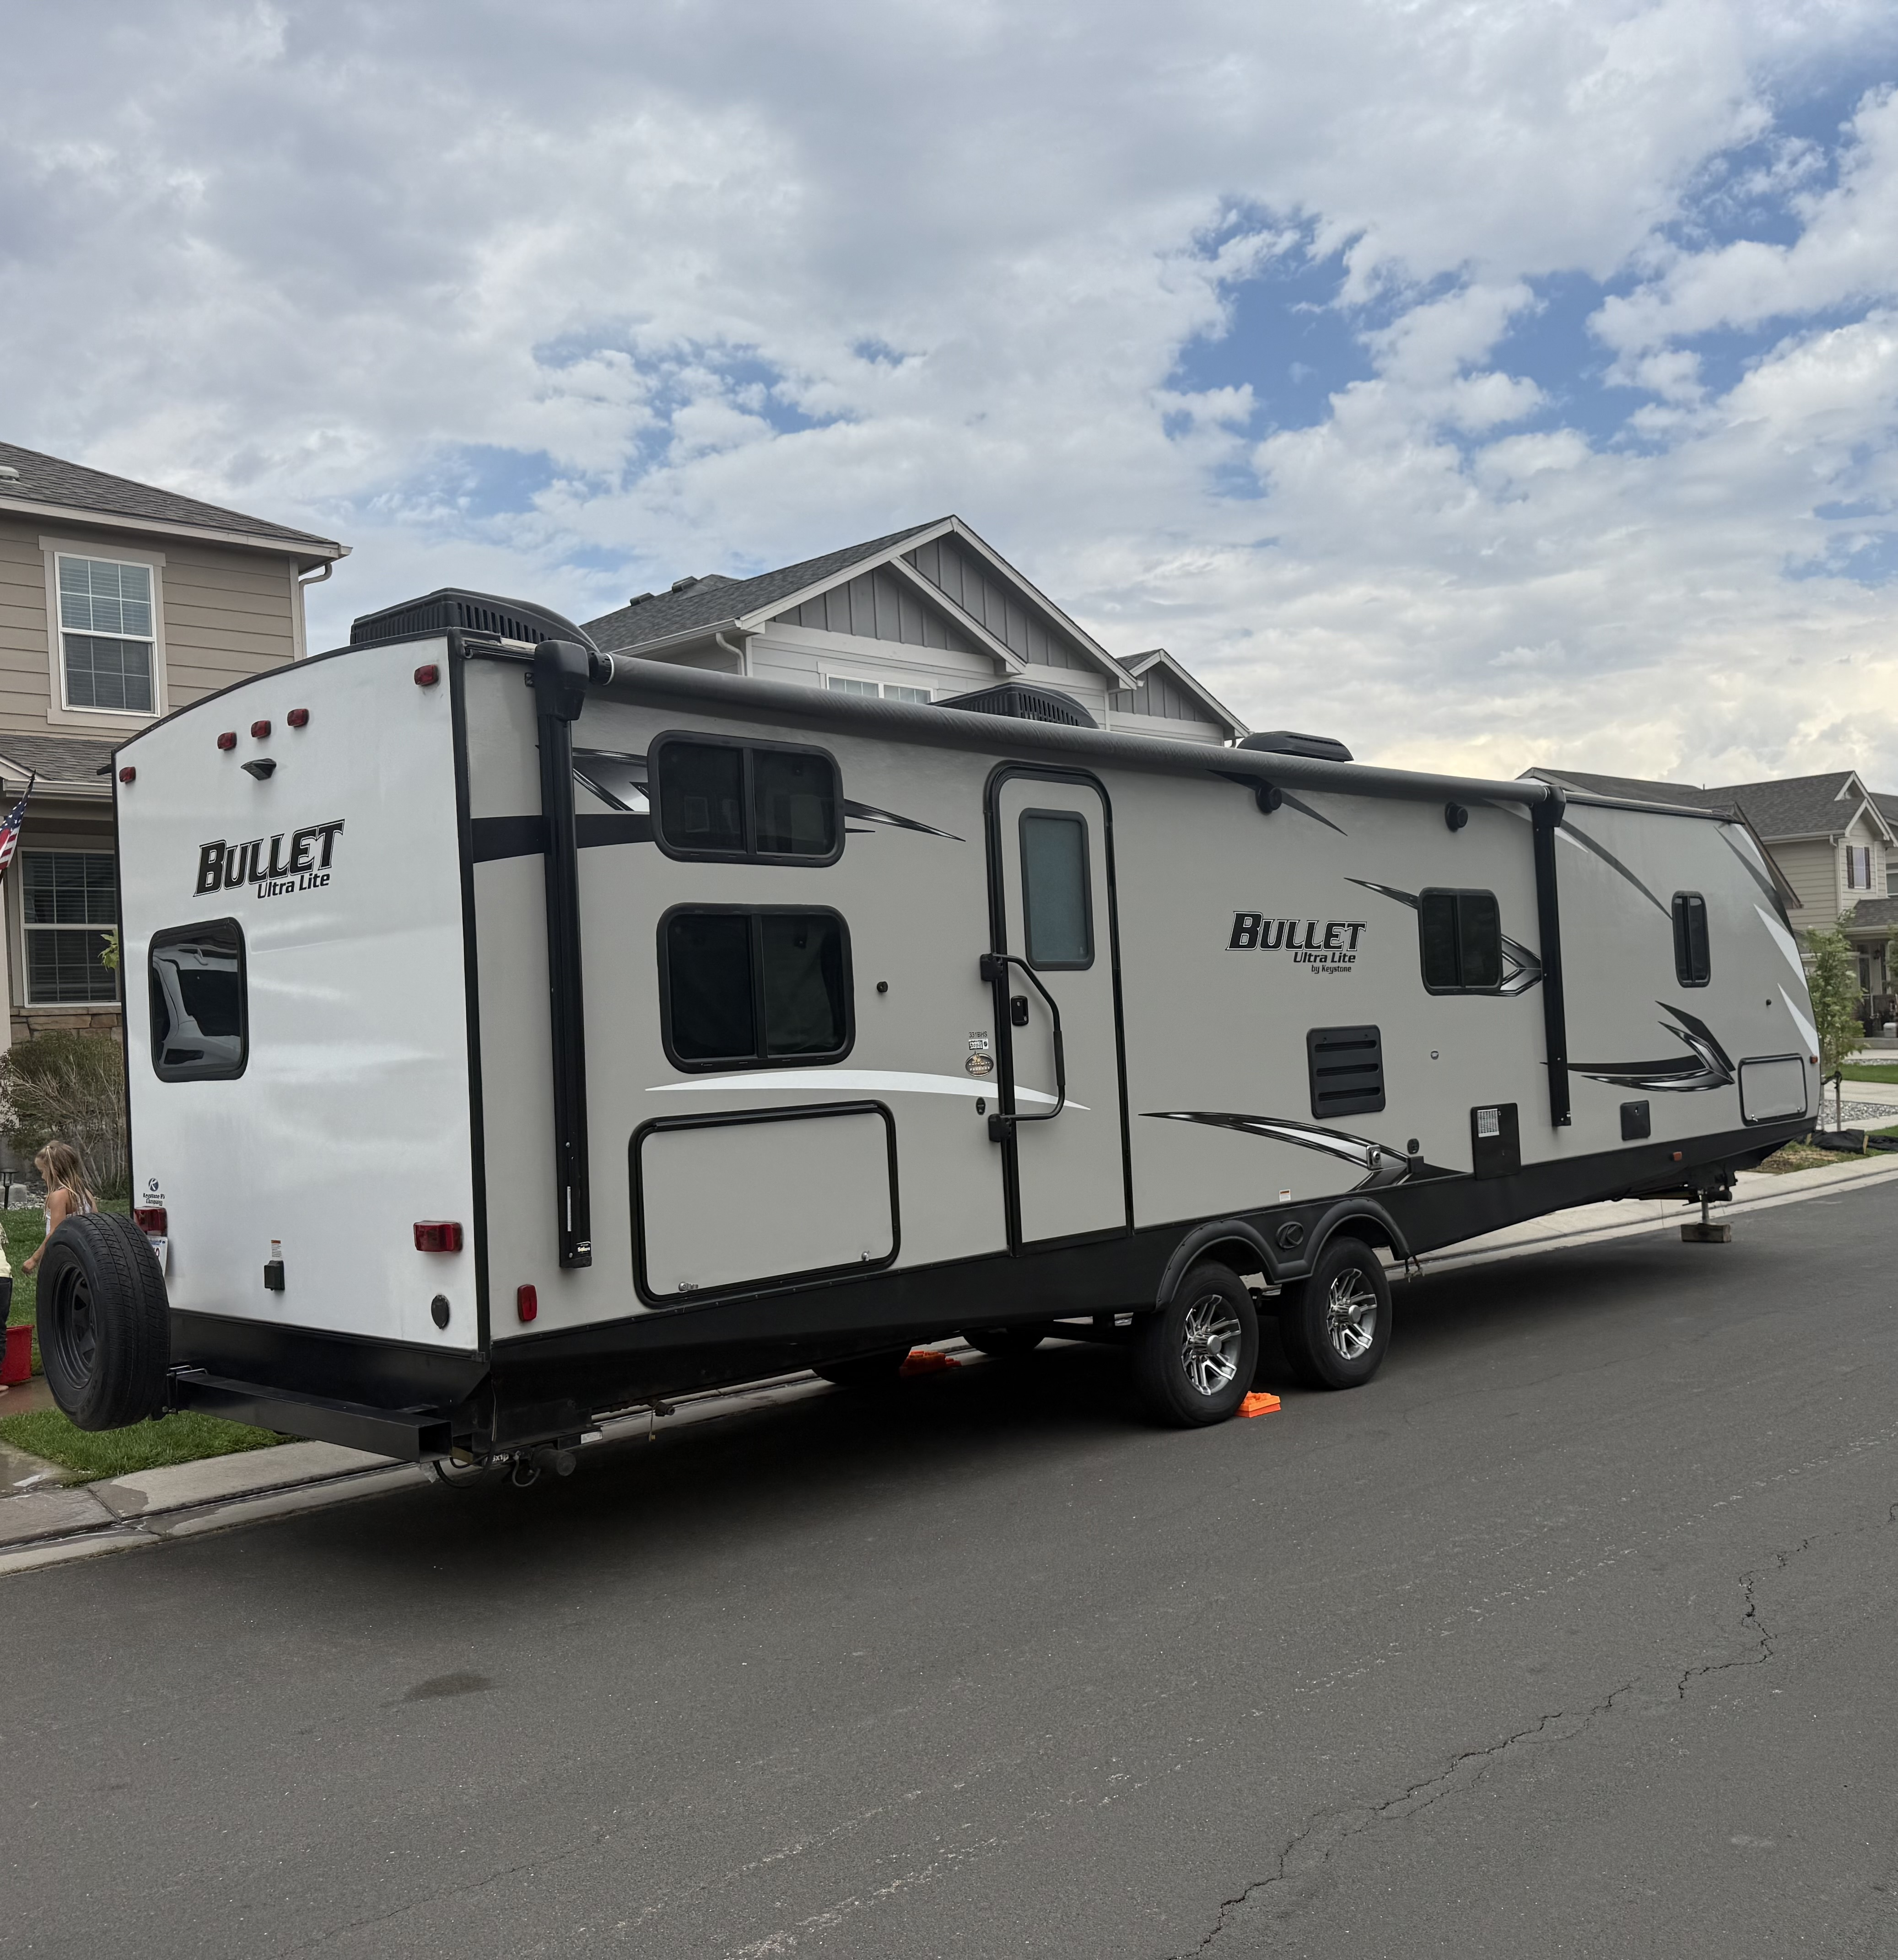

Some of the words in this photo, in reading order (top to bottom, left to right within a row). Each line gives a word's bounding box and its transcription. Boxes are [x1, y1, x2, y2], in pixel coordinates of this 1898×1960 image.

[193, 818, 345, 897] BULLET
[257, 880, 295, 899] Ultra
[299, 873, 330, 891] Lite
[1225, 910, 1367, 952] BULLET
[1293, 952, 1327, 963] Ultra
[1331, 952, 1356, 963] Lite
[1311, 964, 1320, 974] by
[1321, 964, 1352, 974] Keystone
